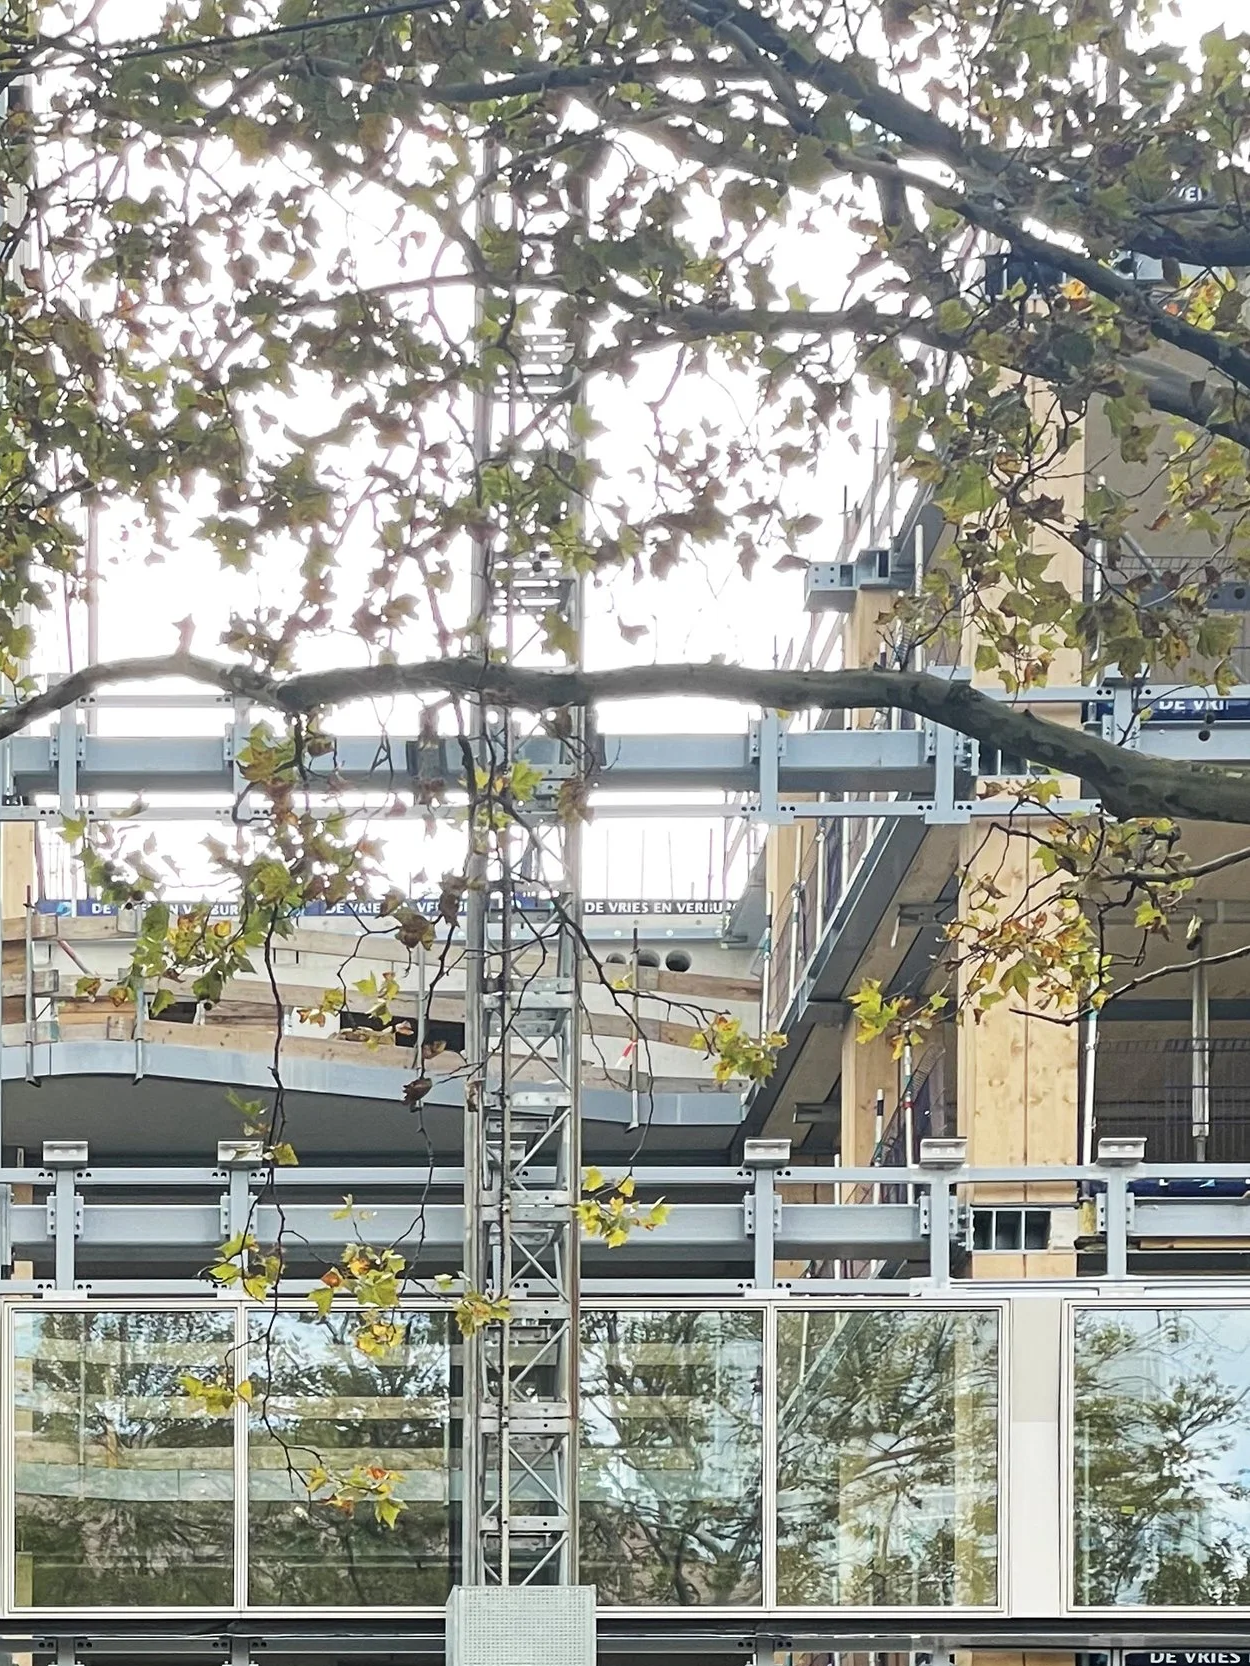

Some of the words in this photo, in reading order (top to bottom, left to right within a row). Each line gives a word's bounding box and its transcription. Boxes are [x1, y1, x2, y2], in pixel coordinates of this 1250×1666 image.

[91, 903, 111, 915] DE
[584, 902, 604, 913] DE
[607, 902, 649, 914] VRIES
[654, 902, 672, 914] EN
[1150, 1653, 1177, 1664] DE
[1184, 1653, 1241, 1664] VRIES
